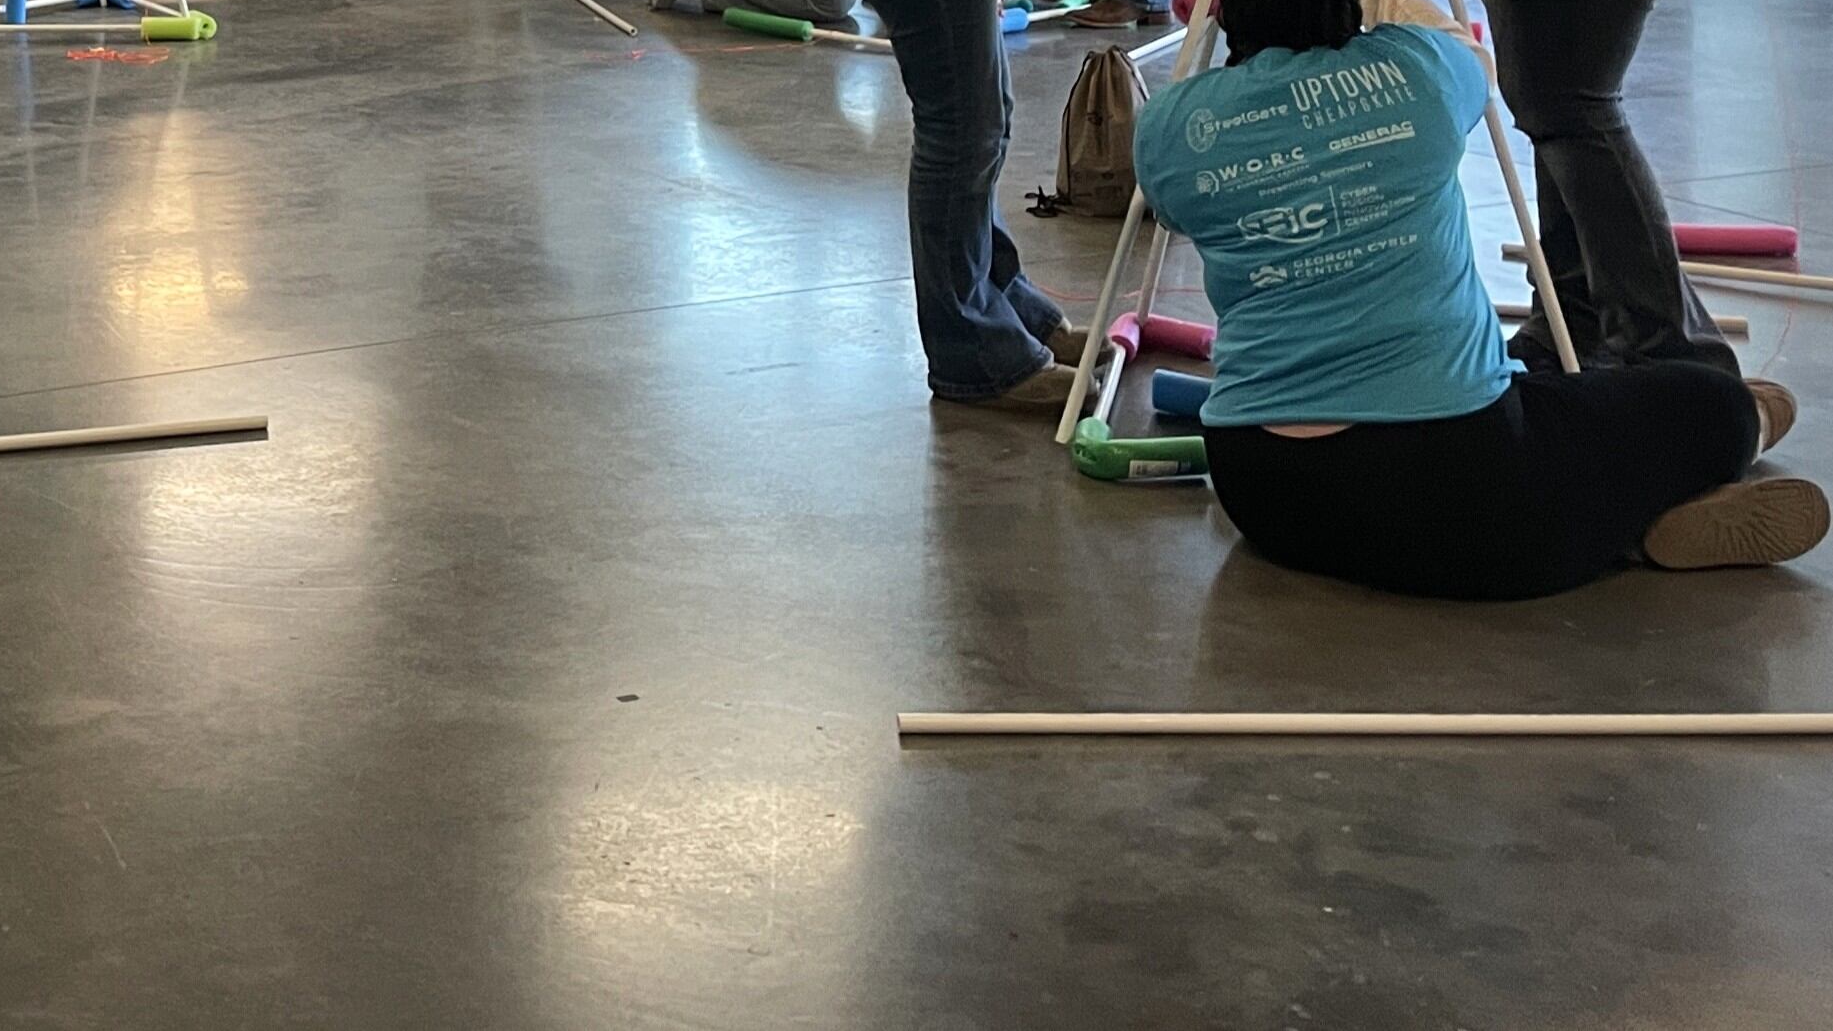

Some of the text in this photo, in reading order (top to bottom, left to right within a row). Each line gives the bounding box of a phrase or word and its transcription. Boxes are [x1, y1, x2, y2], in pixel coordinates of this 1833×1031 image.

[1204, 59, 1407, 134] SteelGate UPTOWN
[1329, 120, 1413, 151] GENERAC
